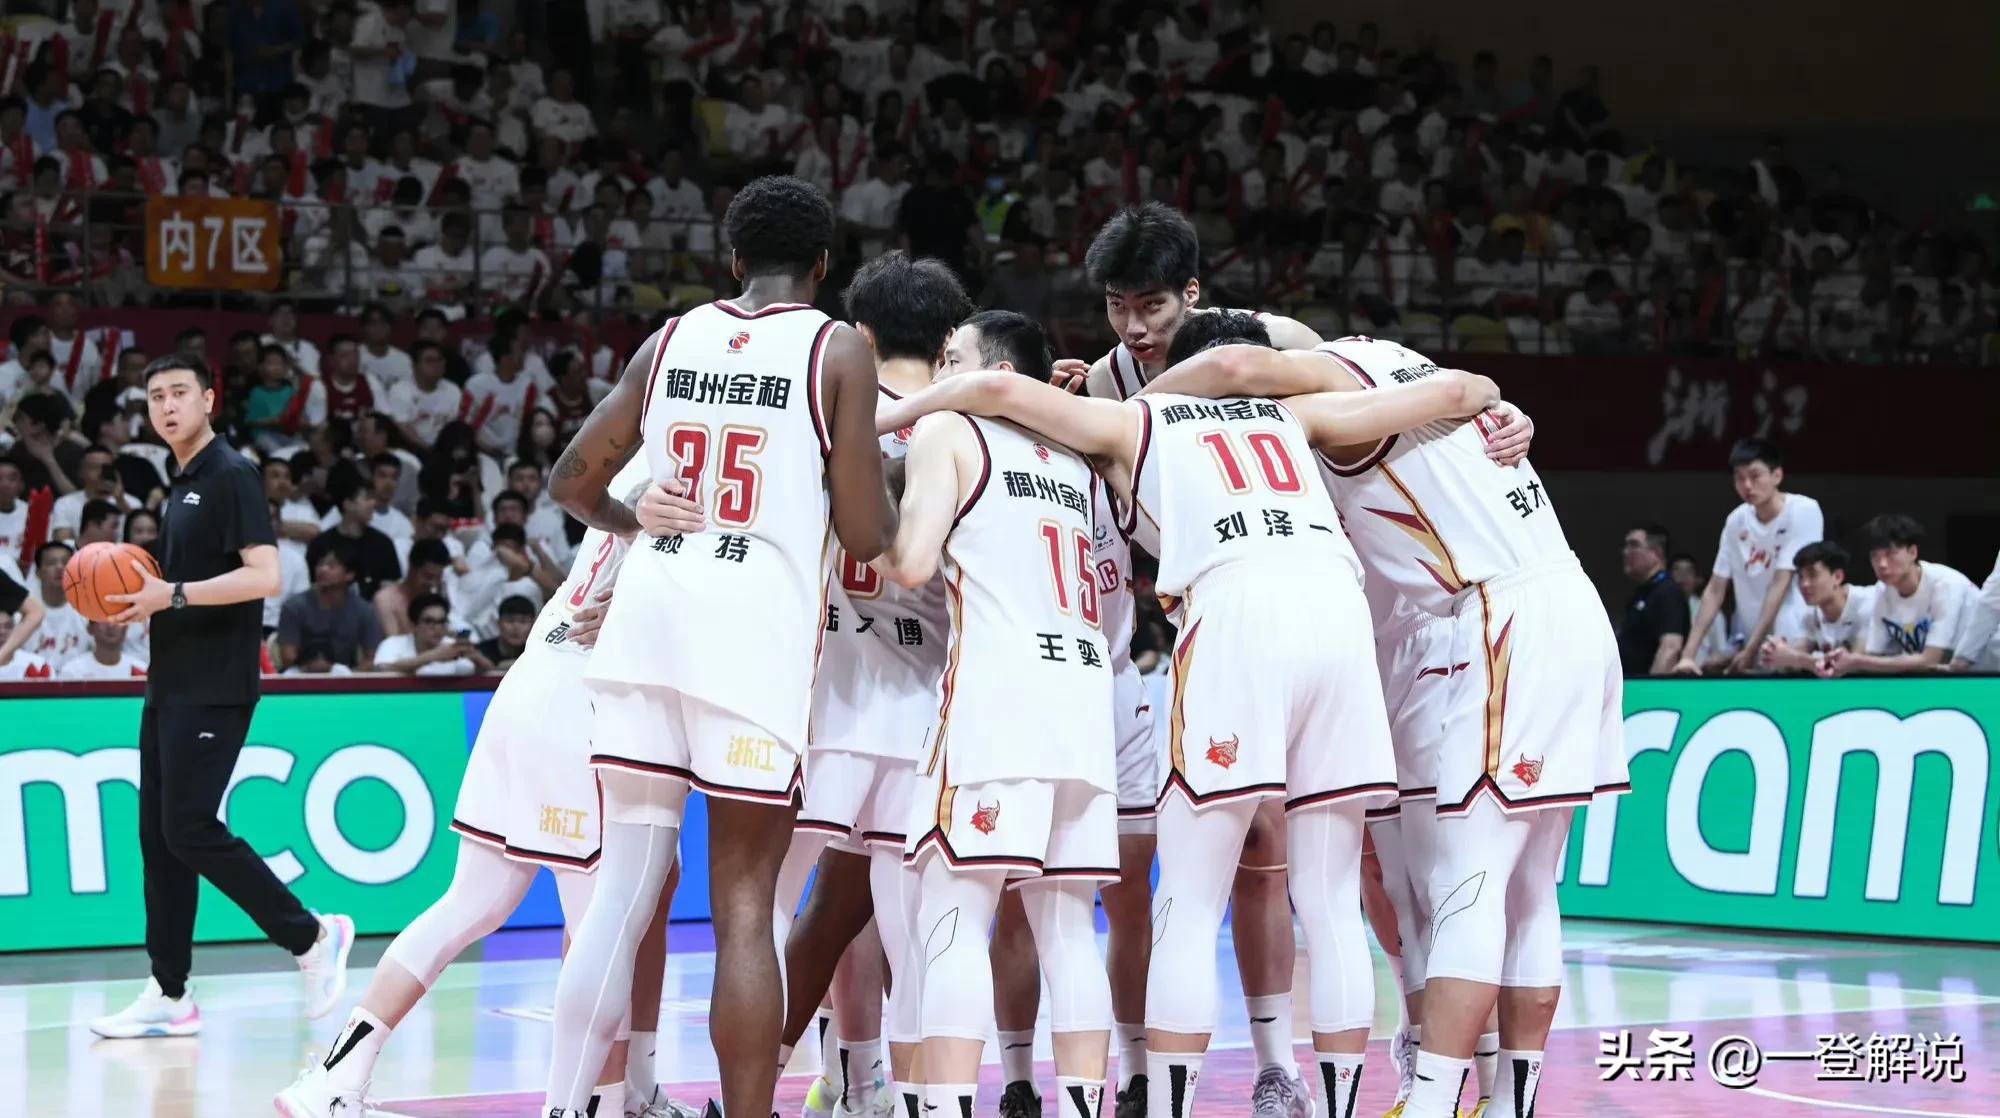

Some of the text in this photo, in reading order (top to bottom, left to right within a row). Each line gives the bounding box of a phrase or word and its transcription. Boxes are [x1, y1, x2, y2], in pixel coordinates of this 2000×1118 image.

[160, 211, 269, 273] 内7区
[666, 368, 791, 410] 稠州金租
[1161, 400, 1284, 425] 稠州金租
[666, 422, 769, 530] 35
[1197, 429, 1309, 496] 10
[1213, 508, 1333, 543] 刘泽一
[1038, 518, 1103, 631] 15
[1036, 632, 1102, 668] 王奕
[726, 735, 777, 772] 浙江
[540, 803, 588, 840] 浙江
[1562, 707, 2000, 906] ram
